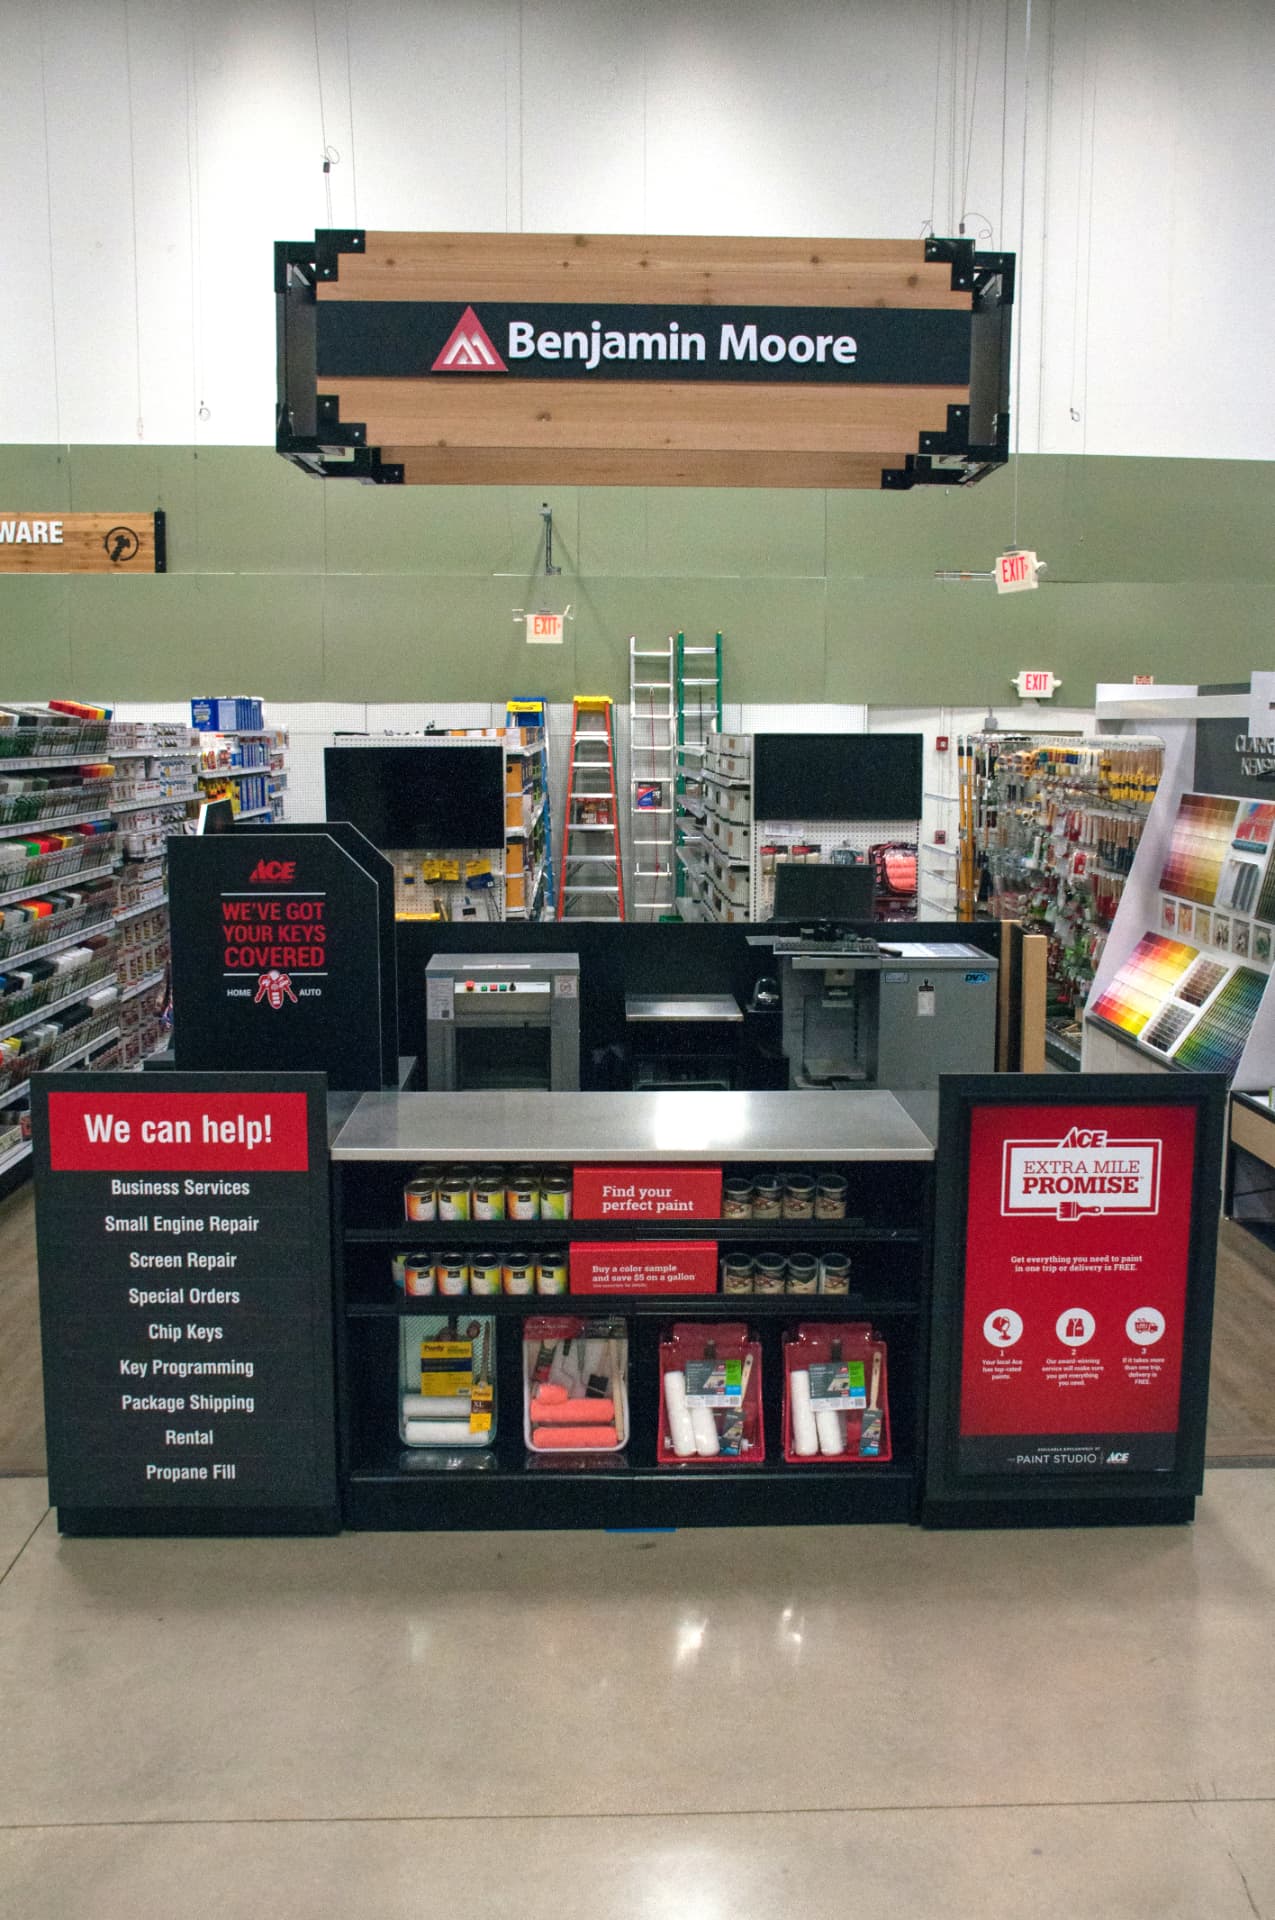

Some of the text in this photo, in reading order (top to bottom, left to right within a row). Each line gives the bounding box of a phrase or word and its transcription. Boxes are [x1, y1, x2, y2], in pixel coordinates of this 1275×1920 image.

[508, 321, 858, 370] Benjamin Moore
[0, 521, 64, 544] WARE
[1002, 556, 1026, 583] EXIT
[533, 616, 557, 636] EXIT
[1025, 673, 1048, 691] EXIT
[249, 859, 296, 881] ACE
[222, 902, 325, 921] WE'VE GOT
[223, 925, 327, 943] YOUR KEYS
[224, 946, 325, 968] COVERED
[227, 989, 322, 997] HOME AUTO
[84, 1114, 272, 1150] We can help!
[1060, 1129, 1106, 1148] ACE
[1023, 1160, 1140, 1174] EXTRA MILE
[111, 1179, 250, 1196] Business Services
[602, 1185, 672, 1201] Find your
[1022, 1176, 1139, 1195] PROMISE
[602, 1199, 694, 1214] perfect paint
[105, 1215, 259, 1235] Small Engine Repair
[129, 1252, 237, 1271] Screen Repair
[592, 1265, 610, 1274] Buy
[619, 1265, 642, 1273] color
[644, 1264, 678, 1273] sample
[1026, 1256, 1071, 1265] everything
[1073, 1257, 1088, 1265] you
[1121, 1255, 1142, 1264] paint
[1042, 1265, 1057, 1273] trip
[1069, 1264, 1102, 1273] delivery
[592, 1274, 609, 1282] and
[129, 1288, 240, 1307] Special Orders
[148, 1323, 223, 1342] Chip Keys
[1000, 1349, 1005, 1357] 1
[1071, 1348, 1077, 1356] 2
[120, 1359, 254, 1378] Key Programming
[122, 1395, 255, 1413] Package Shipping
[165, 1430, 213, 1445] Rental
[1016, 1455, 1050, 1464] PAINT
[1053, 1453, 1097, 1464] STUDIO
[1106, 1452, 1130, 1464] ACE
[146, 1464, 236, 1483] Propane Fill
